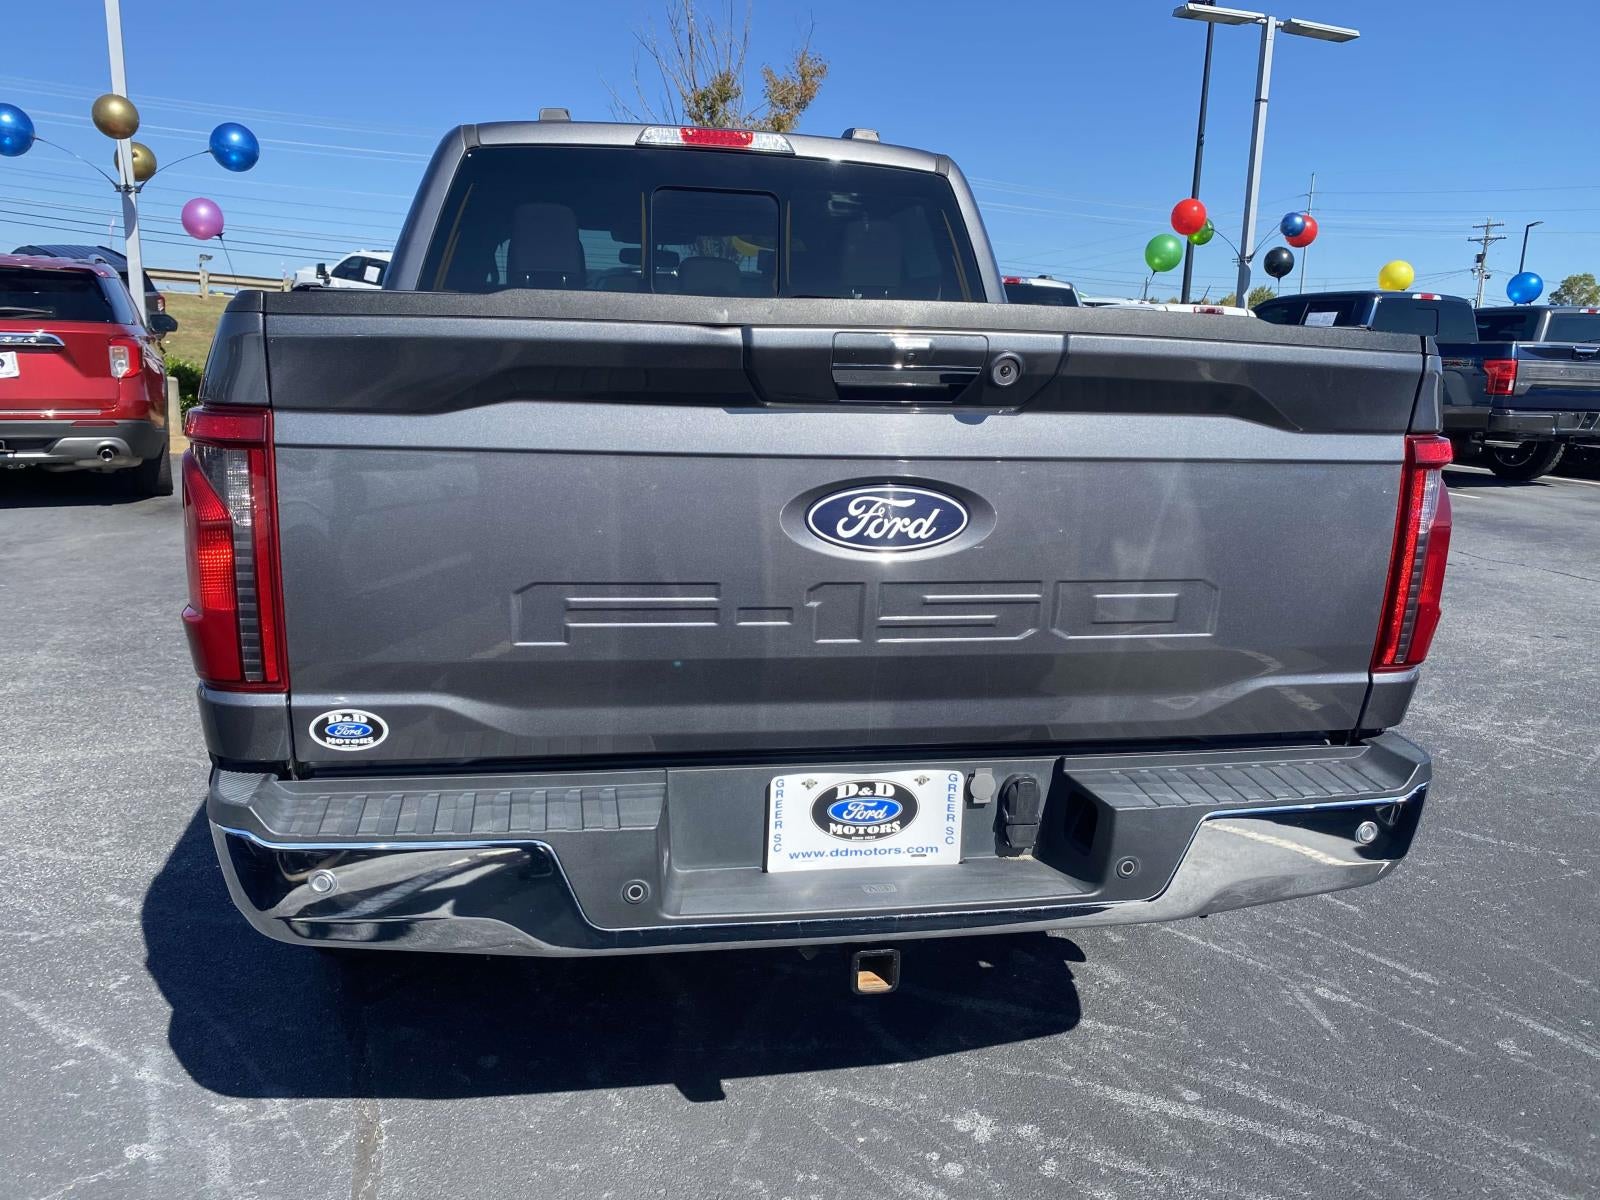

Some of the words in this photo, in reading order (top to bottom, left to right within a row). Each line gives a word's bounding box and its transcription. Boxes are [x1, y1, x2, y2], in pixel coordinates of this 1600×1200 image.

[836, 495, 940, 539] Ford
[510, 578, 1220, 647] F-150
[327, 713, 368, 724] D&D
[335, 725, 363, 735] Ford
[835, 782, 895, 799] D&D
[947, 773, 958, 822] GREER
[775, 779, 784, 829] GREER
[842, 801, 888, 820] Ford
[829, 821, 901, 836] MOTORS
[945, 827, 955, 845] SC
[773, 833, 783, 853] SC
[788, 844, 939, 860] www.ddmotors.com
